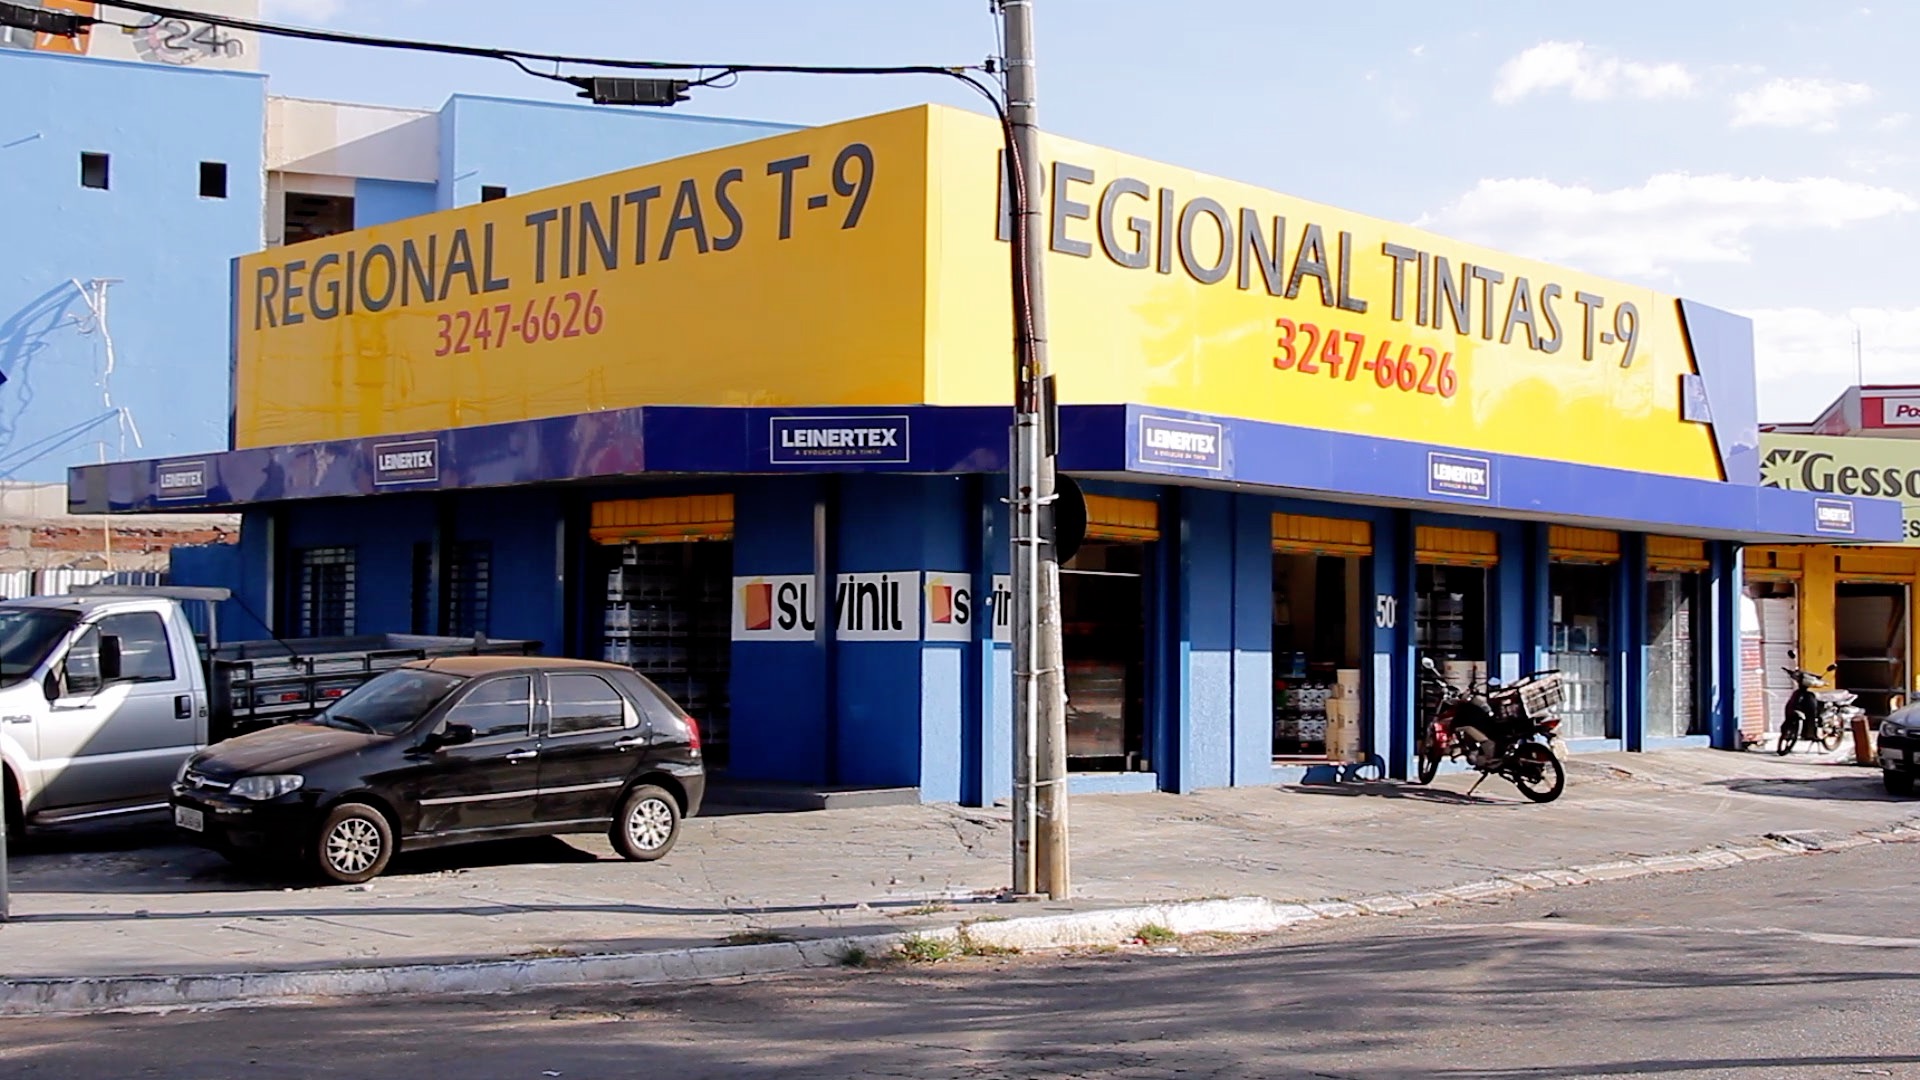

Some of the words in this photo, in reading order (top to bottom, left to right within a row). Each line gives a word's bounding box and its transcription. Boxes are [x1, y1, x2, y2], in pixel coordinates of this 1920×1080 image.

[254, 222, 509, 331] REGIONAL
[525, 167, 744, 284] TINTAS
[766, 142, 875, 241] T-9
[434, 289, 604, 357] 3247-6626
[1382, 242, 1564, 355] TINTAS
[1574, 290, 1641, 369] T-9
[1273, 316, 1458, 399] 3247-6626
[378, 450, 433, 470] LEINERTEX
[781, 428, 898, 448] LEINERTEX
[1146, 428, 1216, 454] LEINERTEX
